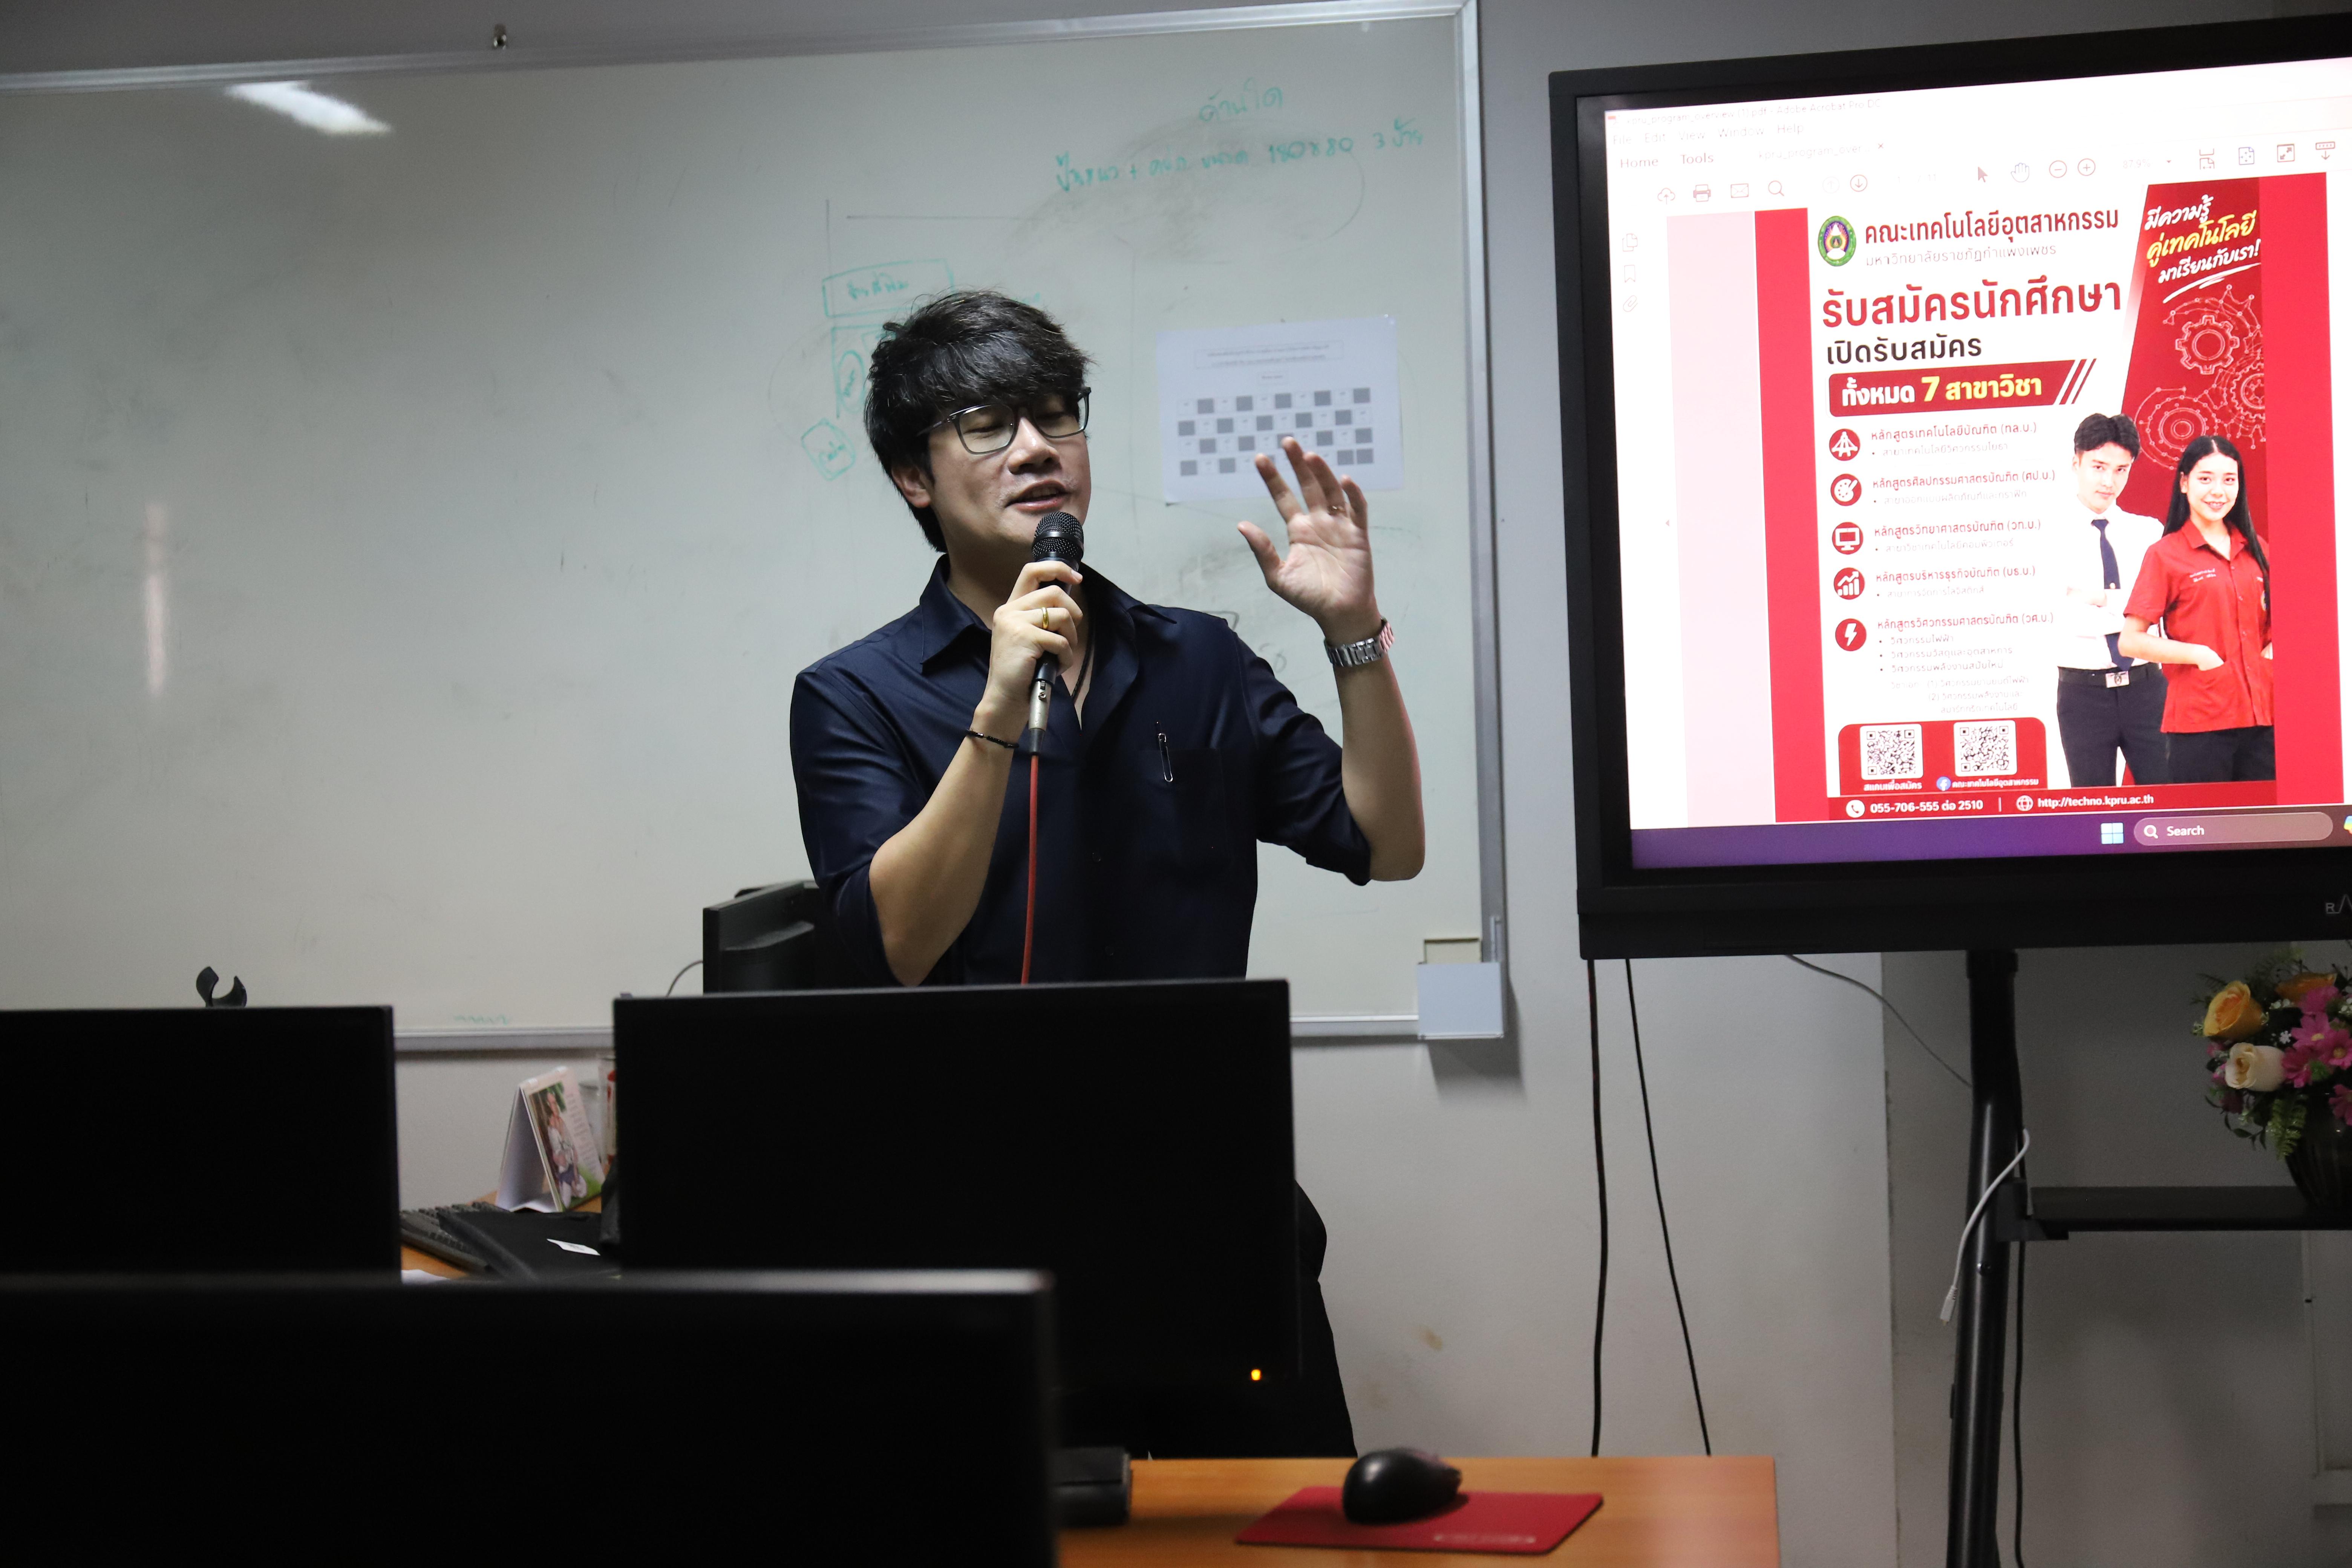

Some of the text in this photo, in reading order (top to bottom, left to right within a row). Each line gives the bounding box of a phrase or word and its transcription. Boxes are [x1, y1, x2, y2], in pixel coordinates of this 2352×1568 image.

[1776, 104, 1807, 115] Adobe
[1810, 101, 1846, 112] Acrobat
[1849, 100, 1864, 110] Pro
[1867, 99, 1881, 109] DC
[1614, 123, 1804, 145] File Edit View Window Help
[1620, 156, 1658, 168] Home
[1680, 152, 1714, 165] Tools
[1865, 208, 2119, 243] คณะเทคโนโลยีอุตสาหกรรม
[2144, 194, 2214, 231] มีความรู้
[2147, 210, 2257, 268] คู่เทคโนโลยี
[2158, 238, 2261, 283] มาเรียนกับเรา!
[1822, 274, 2121, 328] รับสมัครนักศึกษา
[1827, 333, 1982, 364] เปิดรับสมัคร
[1842, 373, 2042, 406] ทั้งหมด 7 สาขาวิชา
[1870, 801, 1940, 813] 055-706-555
[1958, 799, 1983, 811] 2510
[2037, 794, 2154, 809] http://techno.kpru.ac.th
[2167, 825, 2205, 836] Search
